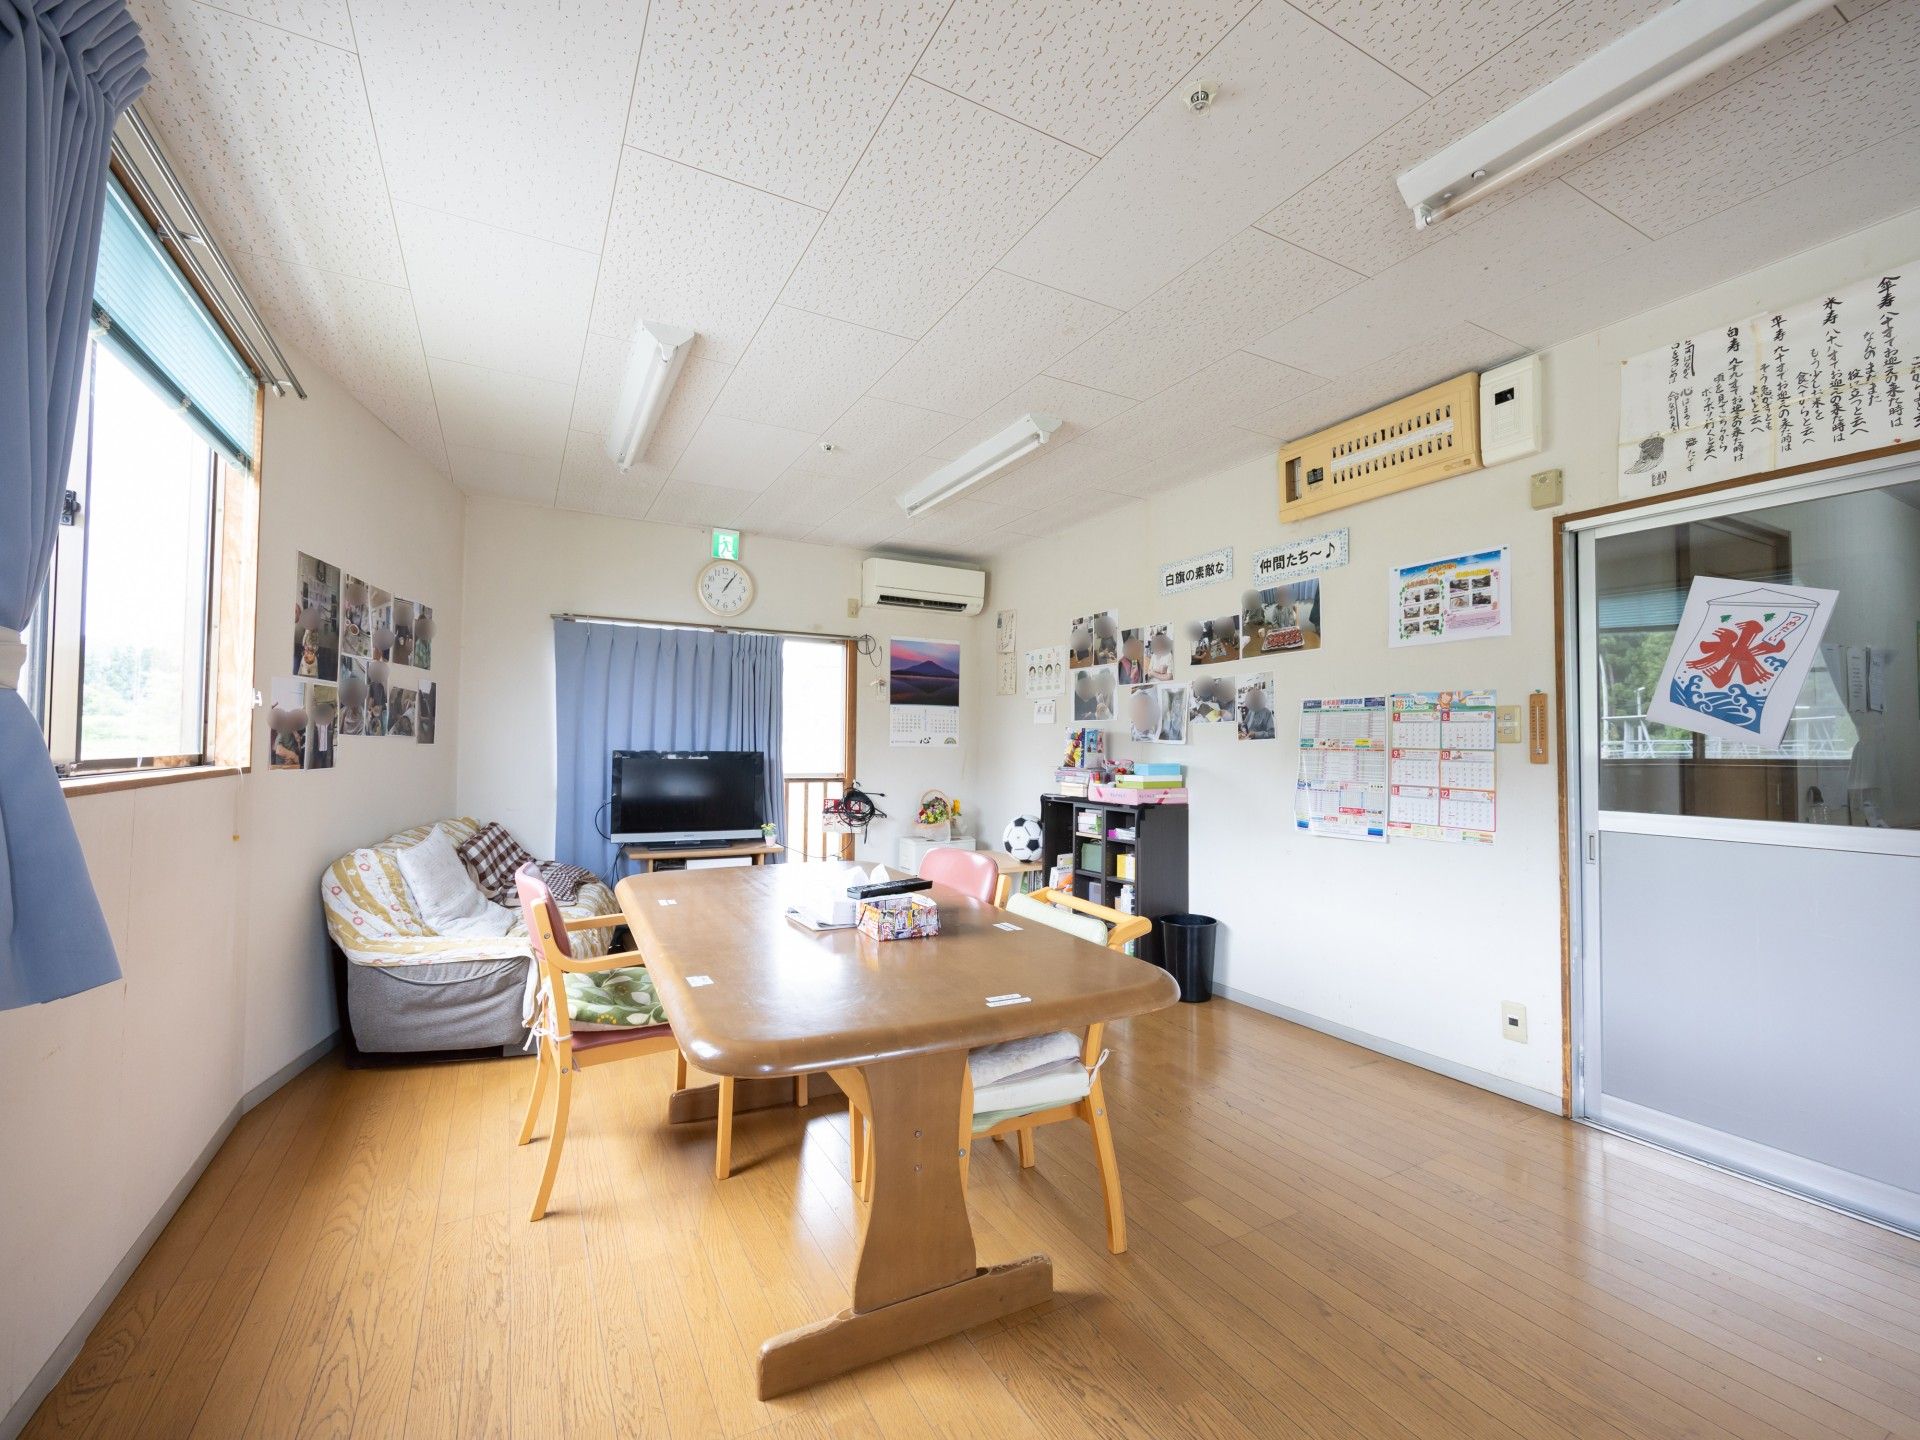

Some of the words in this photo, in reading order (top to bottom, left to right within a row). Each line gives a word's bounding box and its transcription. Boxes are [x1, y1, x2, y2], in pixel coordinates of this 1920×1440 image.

[1823, 296, 1843, 325] 米寿
[1726, 326, 1741, 353] 白寿
[1165, 561, 1225, 587] 白旗の素敵な
[1685, 619, 1786, 689] 氷
